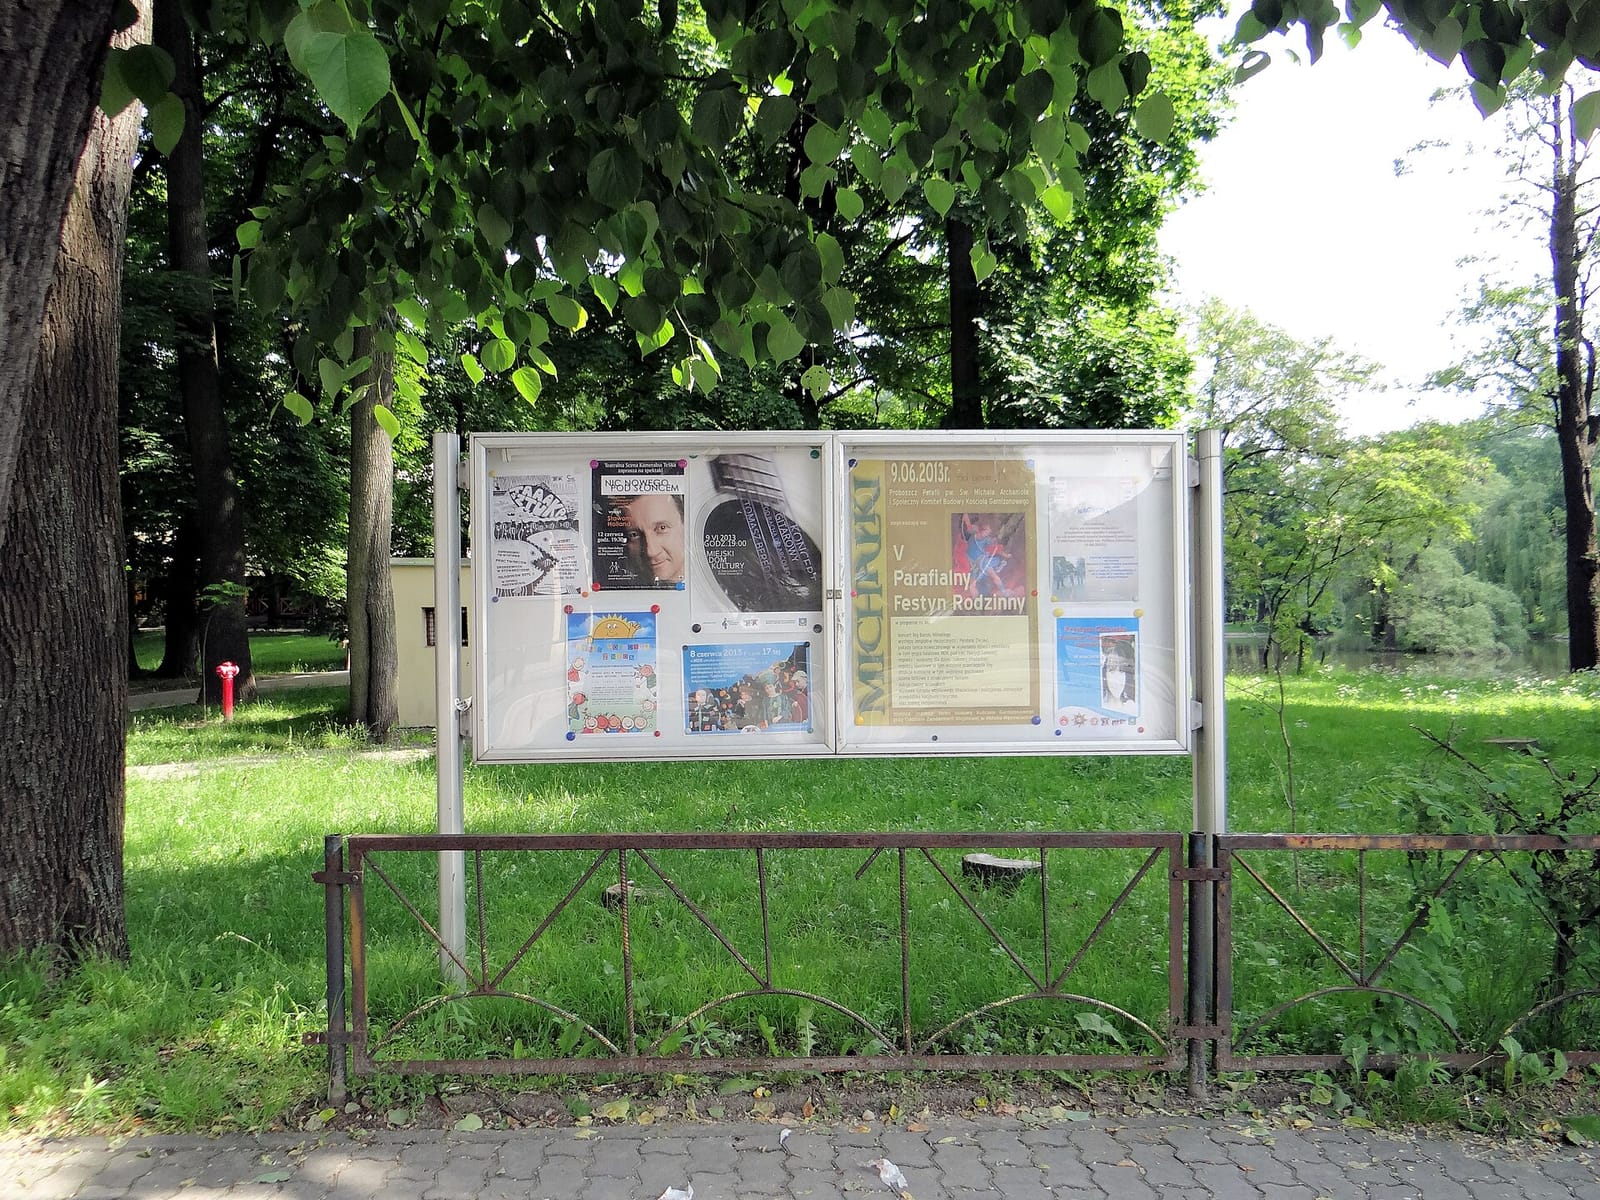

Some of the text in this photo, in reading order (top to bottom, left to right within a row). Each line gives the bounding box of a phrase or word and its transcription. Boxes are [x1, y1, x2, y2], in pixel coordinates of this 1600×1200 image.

[891, 462, 950, 482] 9.06.2013r.
[605, 479, 669, 487] NIC NOWEGO
[775, 512, 799, 562] GITAROWY
[708, 556, 727, 564] DOM
[893, 544, 904, 561] V
[711, 562, 745, 570] KULTURY
[893, 569, 971, 591] Parafialny
[893, 594, 1026, 615] Festyn Rodzinny
[762, 648, 772, 656] 17
